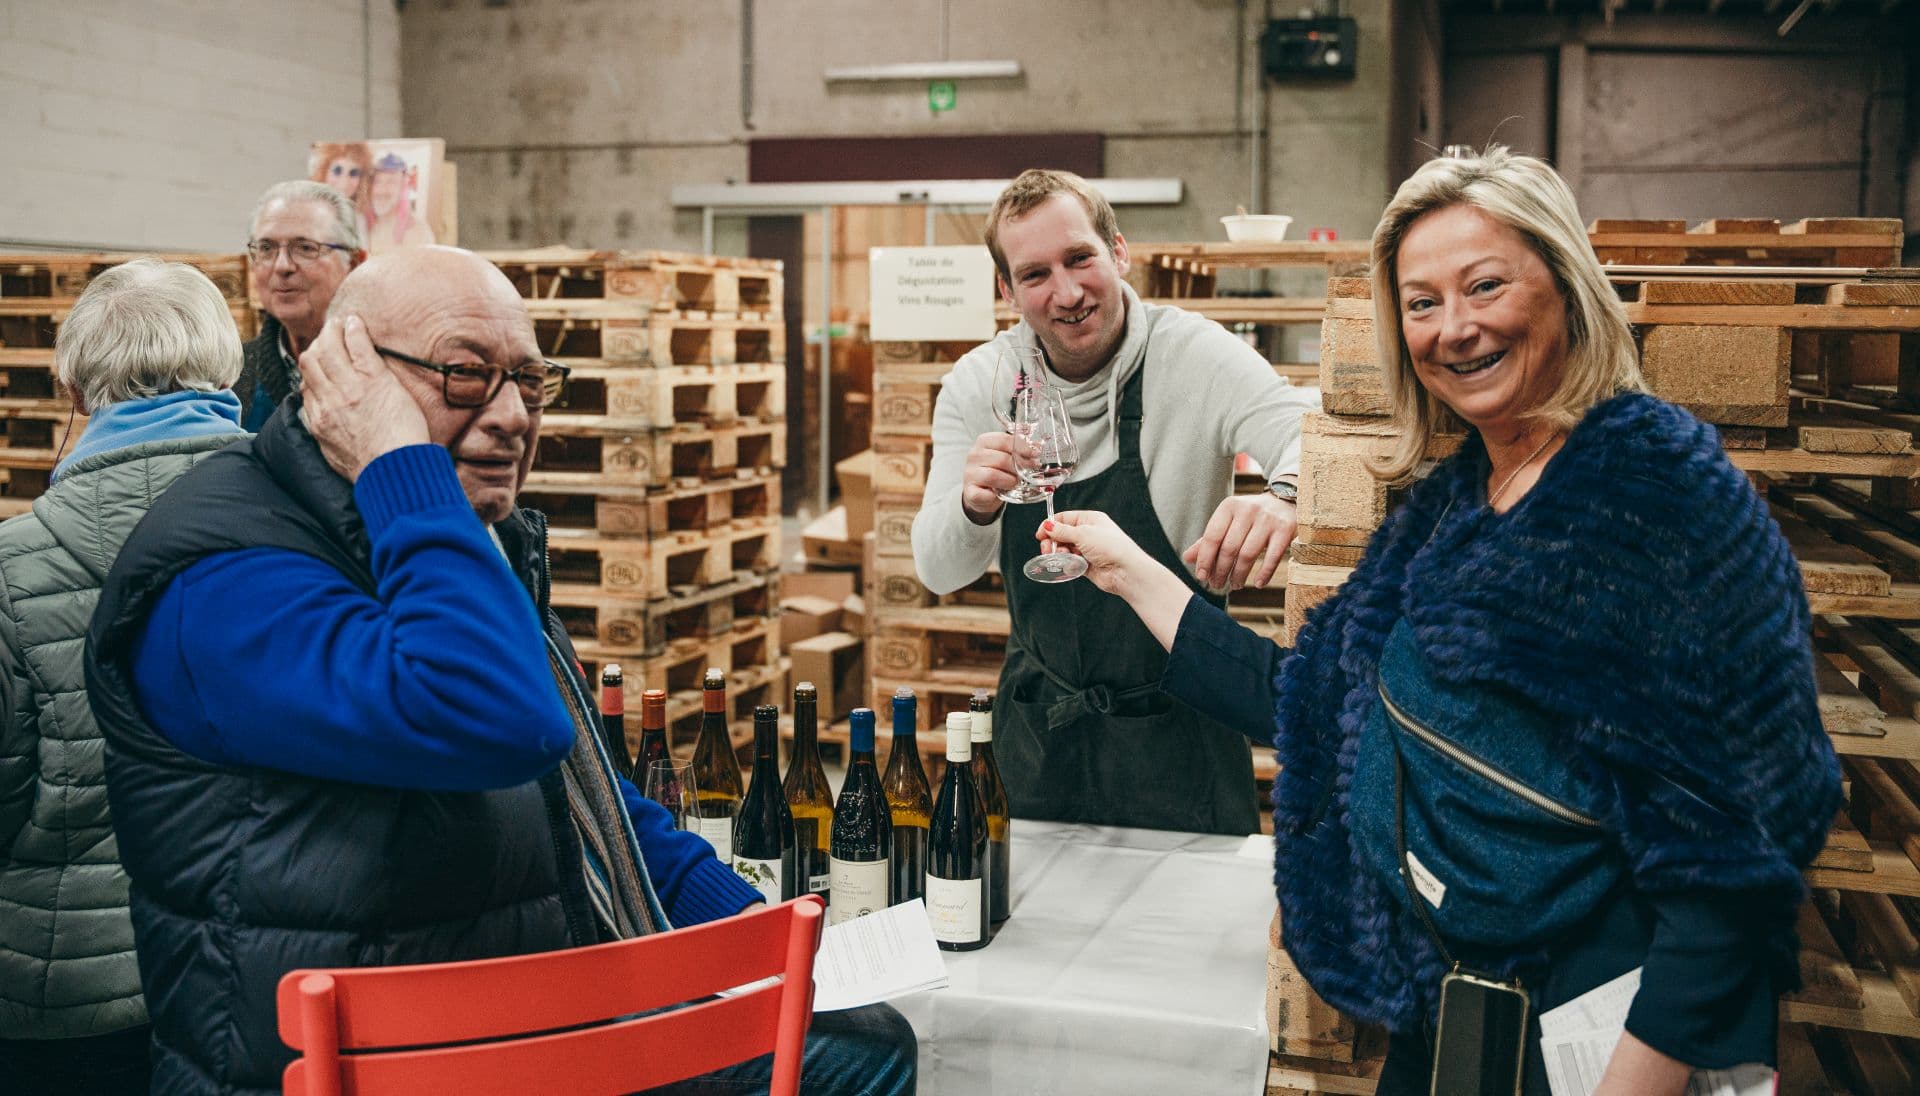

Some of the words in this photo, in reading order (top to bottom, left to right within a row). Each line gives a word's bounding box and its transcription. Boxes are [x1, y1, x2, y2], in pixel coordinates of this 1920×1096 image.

[908, 256, 937, 267] Table
[941, 256, 954, 267] de
[897, 296, 921, 305] Vins
[924, 296, 965, 308] Rouges
